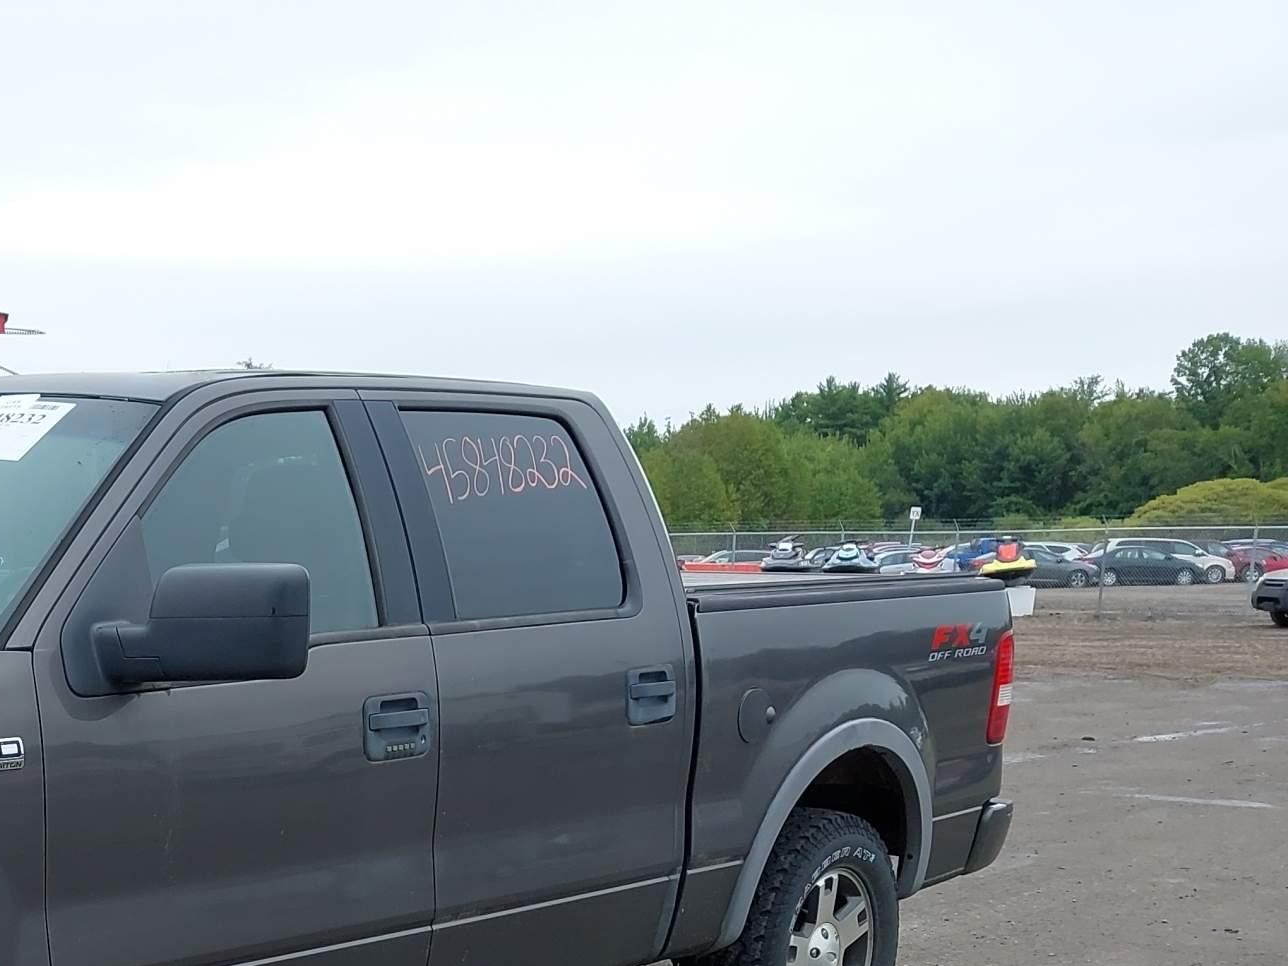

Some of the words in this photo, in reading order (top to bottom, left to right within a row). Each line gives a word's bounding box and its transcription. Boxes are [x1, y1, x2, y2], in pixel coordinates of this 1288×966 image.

[418, 434, 588, 505] 45848232
[931, 622, 989, 650] FX4
[928, 650, 952, 662] OFF
[954, 646, 987, 658] ROAD
